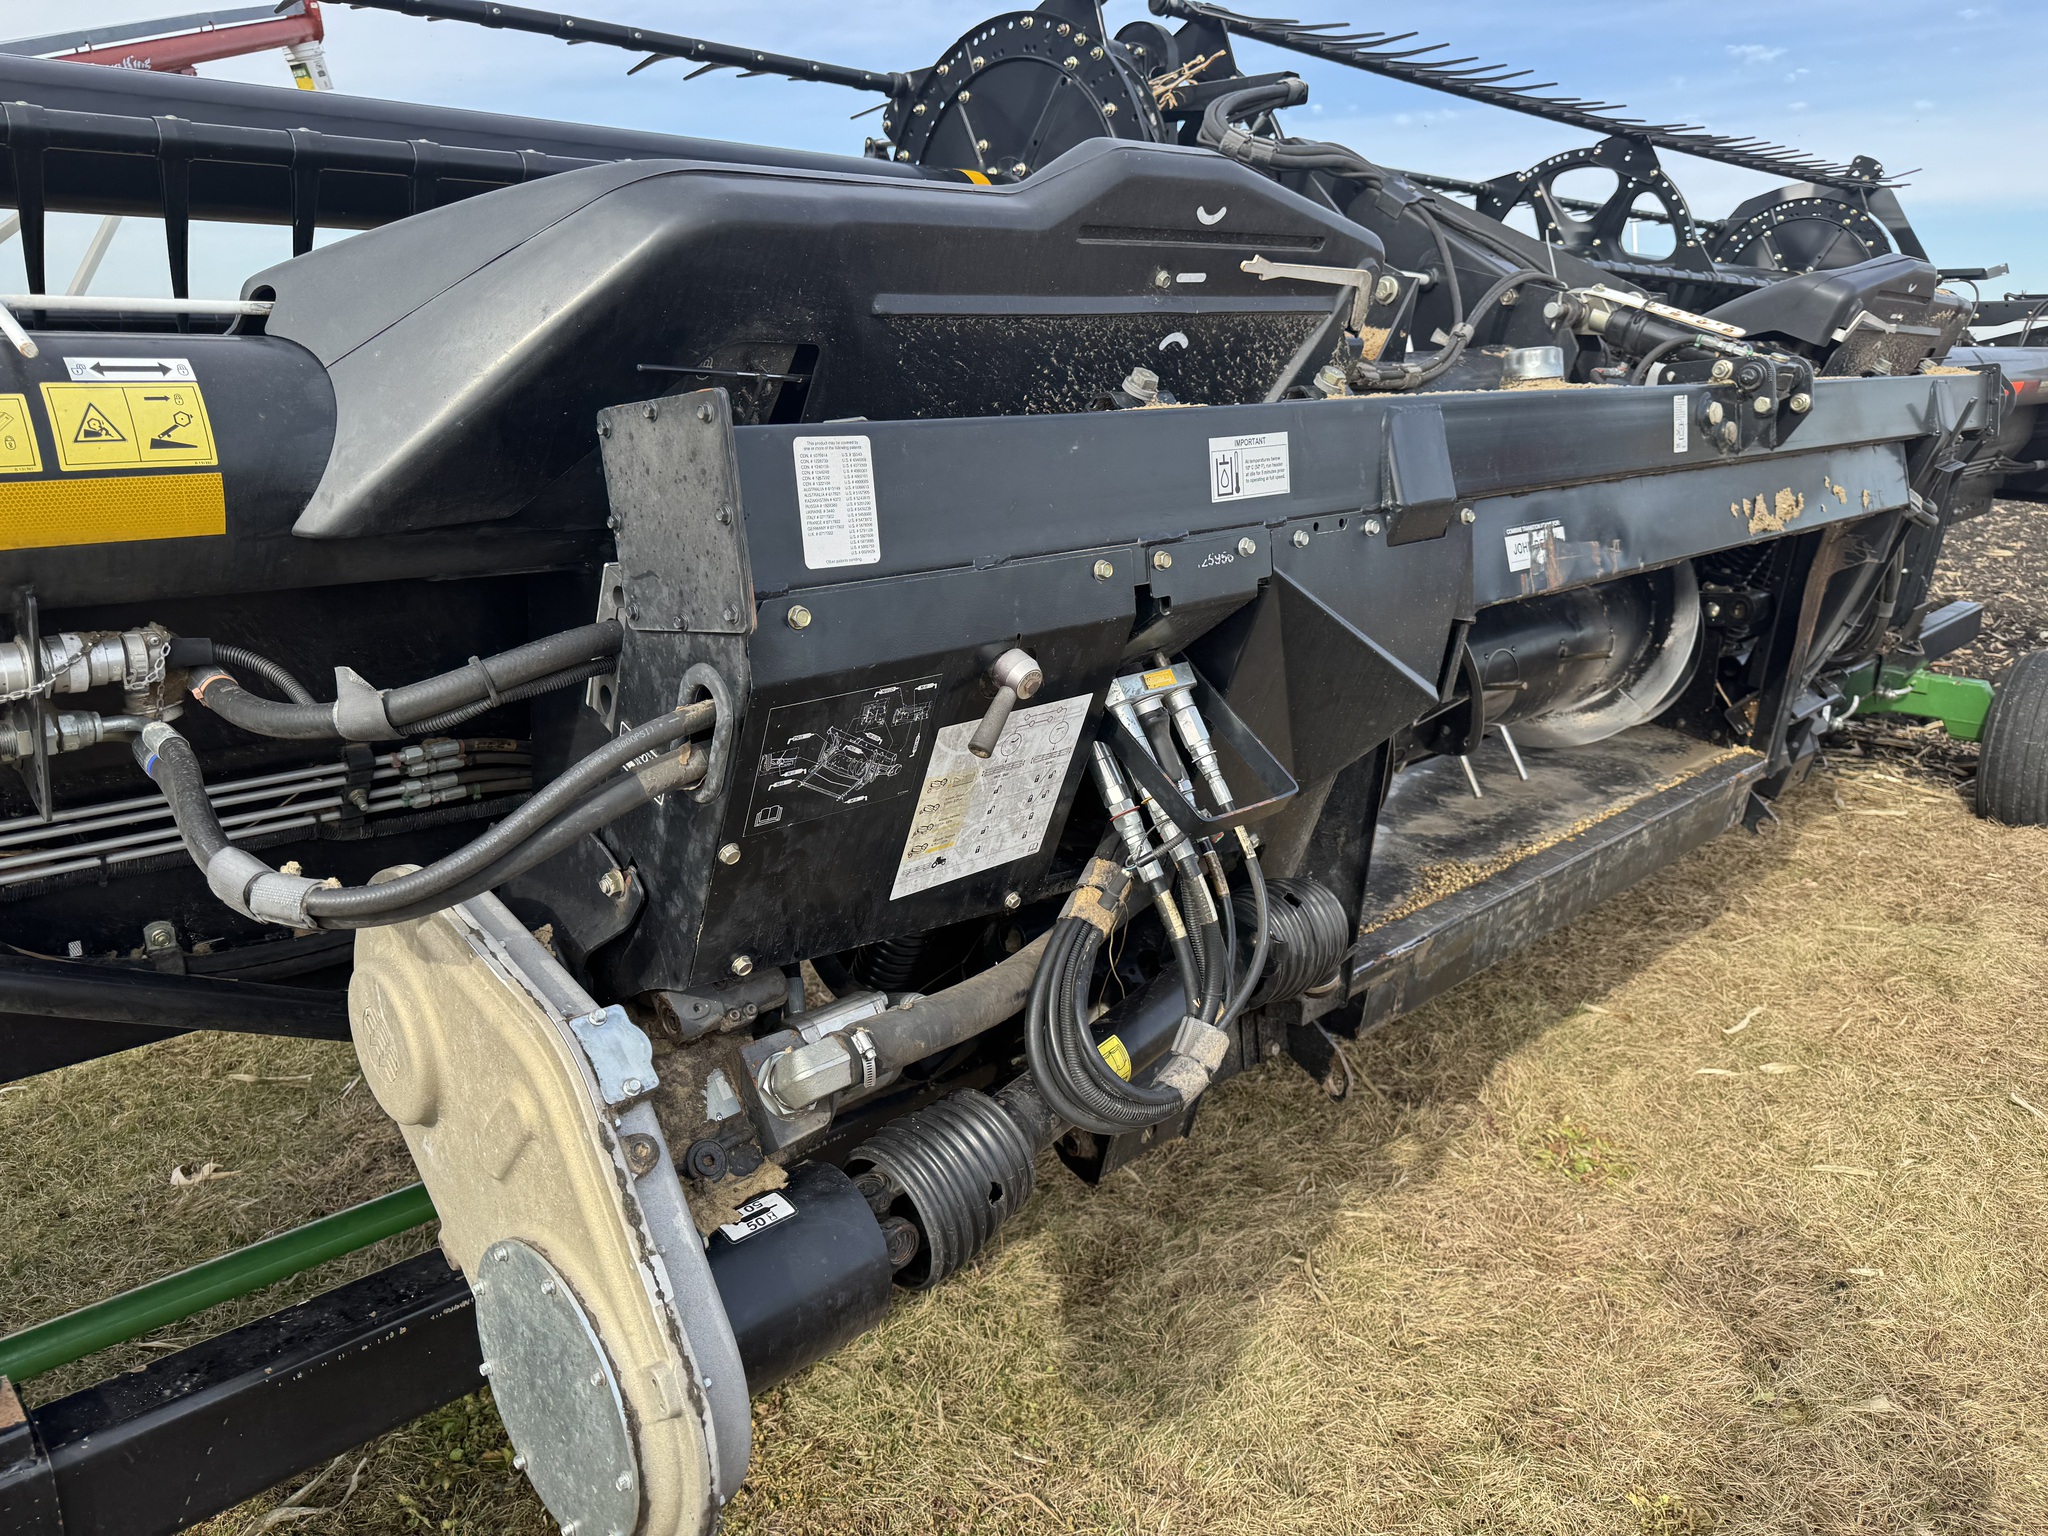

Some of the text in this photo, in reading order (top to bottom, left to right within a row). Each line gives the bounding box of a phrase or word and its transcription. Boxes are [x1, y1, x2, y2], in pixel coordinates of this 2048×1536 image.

[1235, 437, 1266, 446] IMPORTANT
[1513, 542, 1530, 555] JOH
[611, 725, 655, 754] (3000PSI)
[743, 1201, 763, 1212] 50
[746, 1217, 767, 1231] 50
